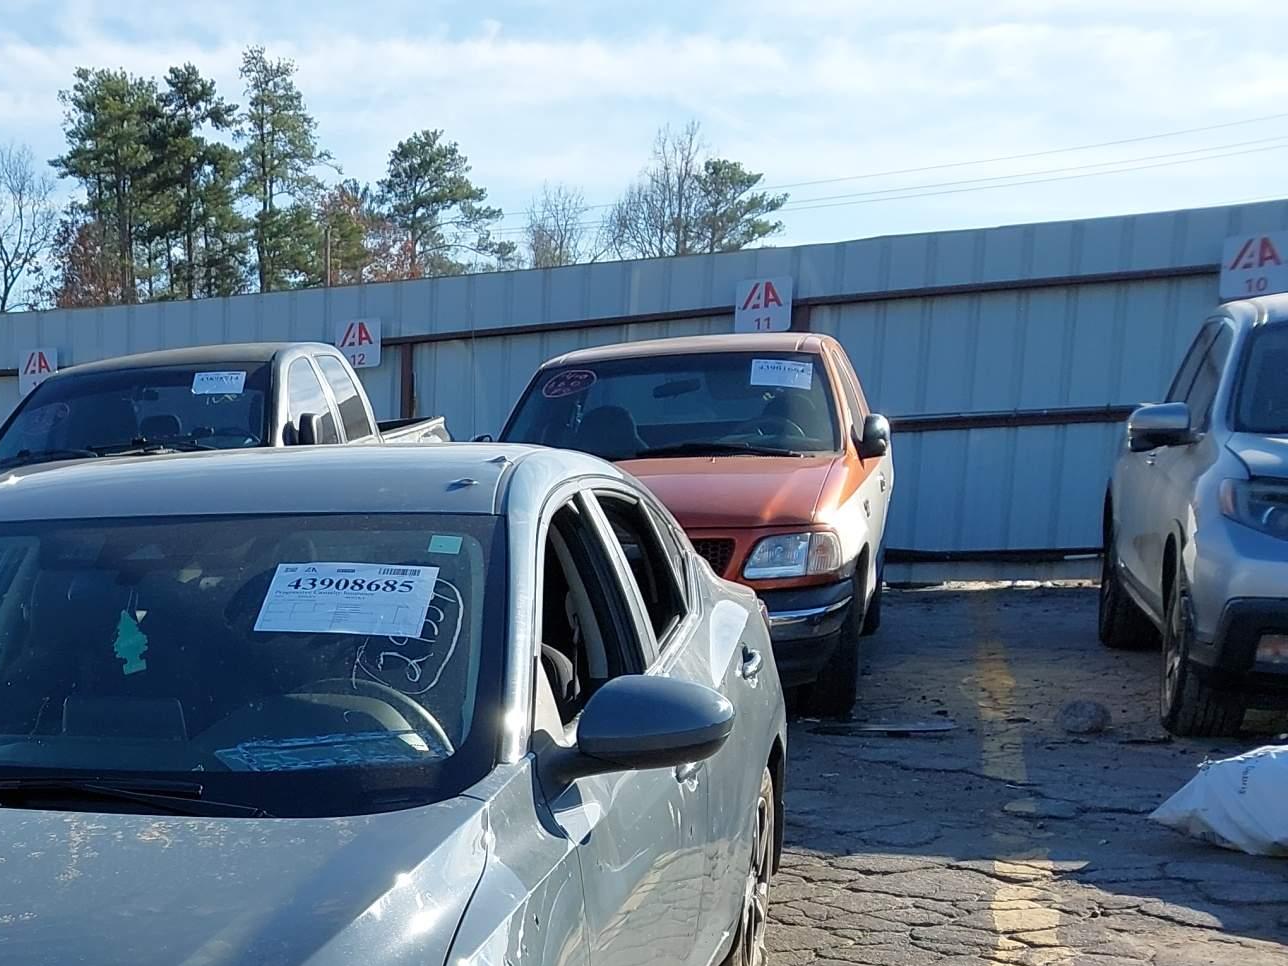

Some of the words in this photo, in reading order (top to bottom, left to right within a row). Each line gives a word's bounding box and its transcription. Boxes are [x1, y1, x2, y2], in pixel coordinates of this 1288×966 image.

[1245, 277, 1268, 293] 10
[754, 316, 770, 330] 11
[351, 353, 366, 366] 12
[287, 578, 415, 593] 43908685
